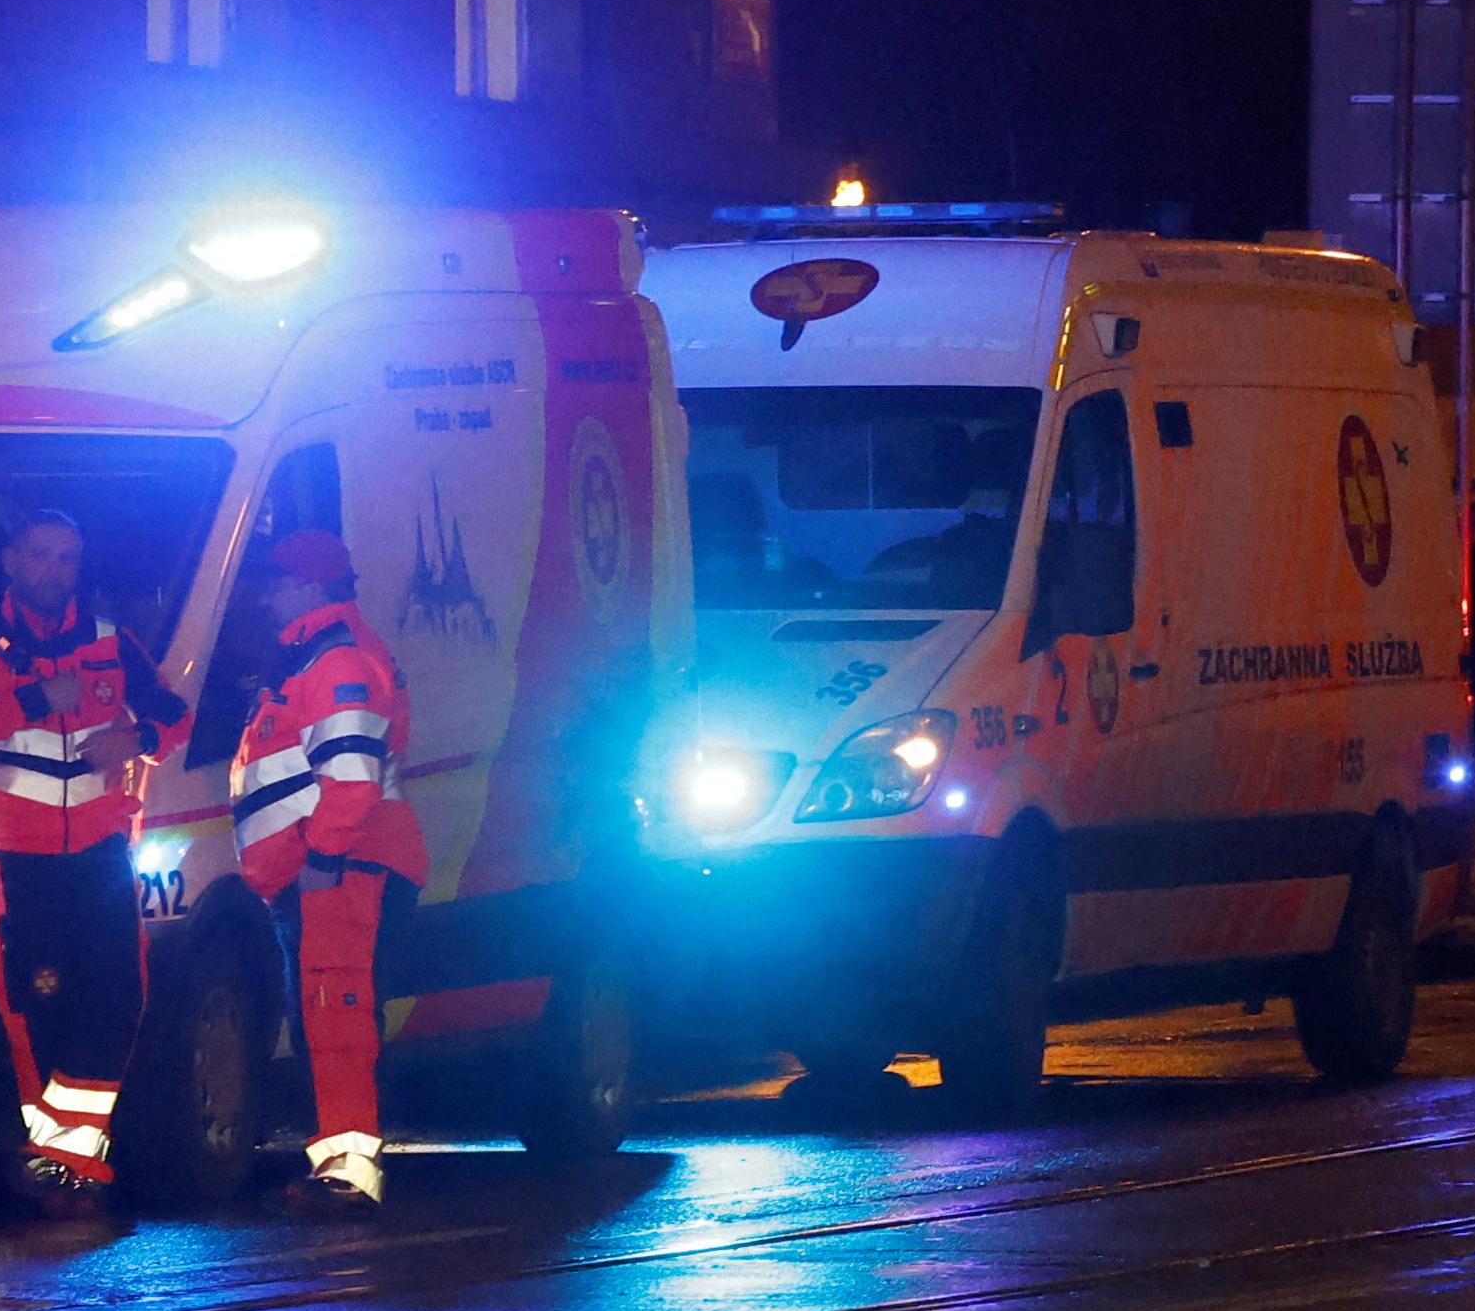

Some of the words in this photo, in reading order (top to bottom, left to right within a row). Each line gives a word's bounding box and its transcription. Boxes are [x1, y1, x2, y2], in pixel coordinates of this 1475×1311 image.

[1346, 633, 1425, 677] SLUŽBA
[815, 660, 888, 706] 356
[970, 705, 1008, 750] 356
[138, 869, 189, 919] 212
